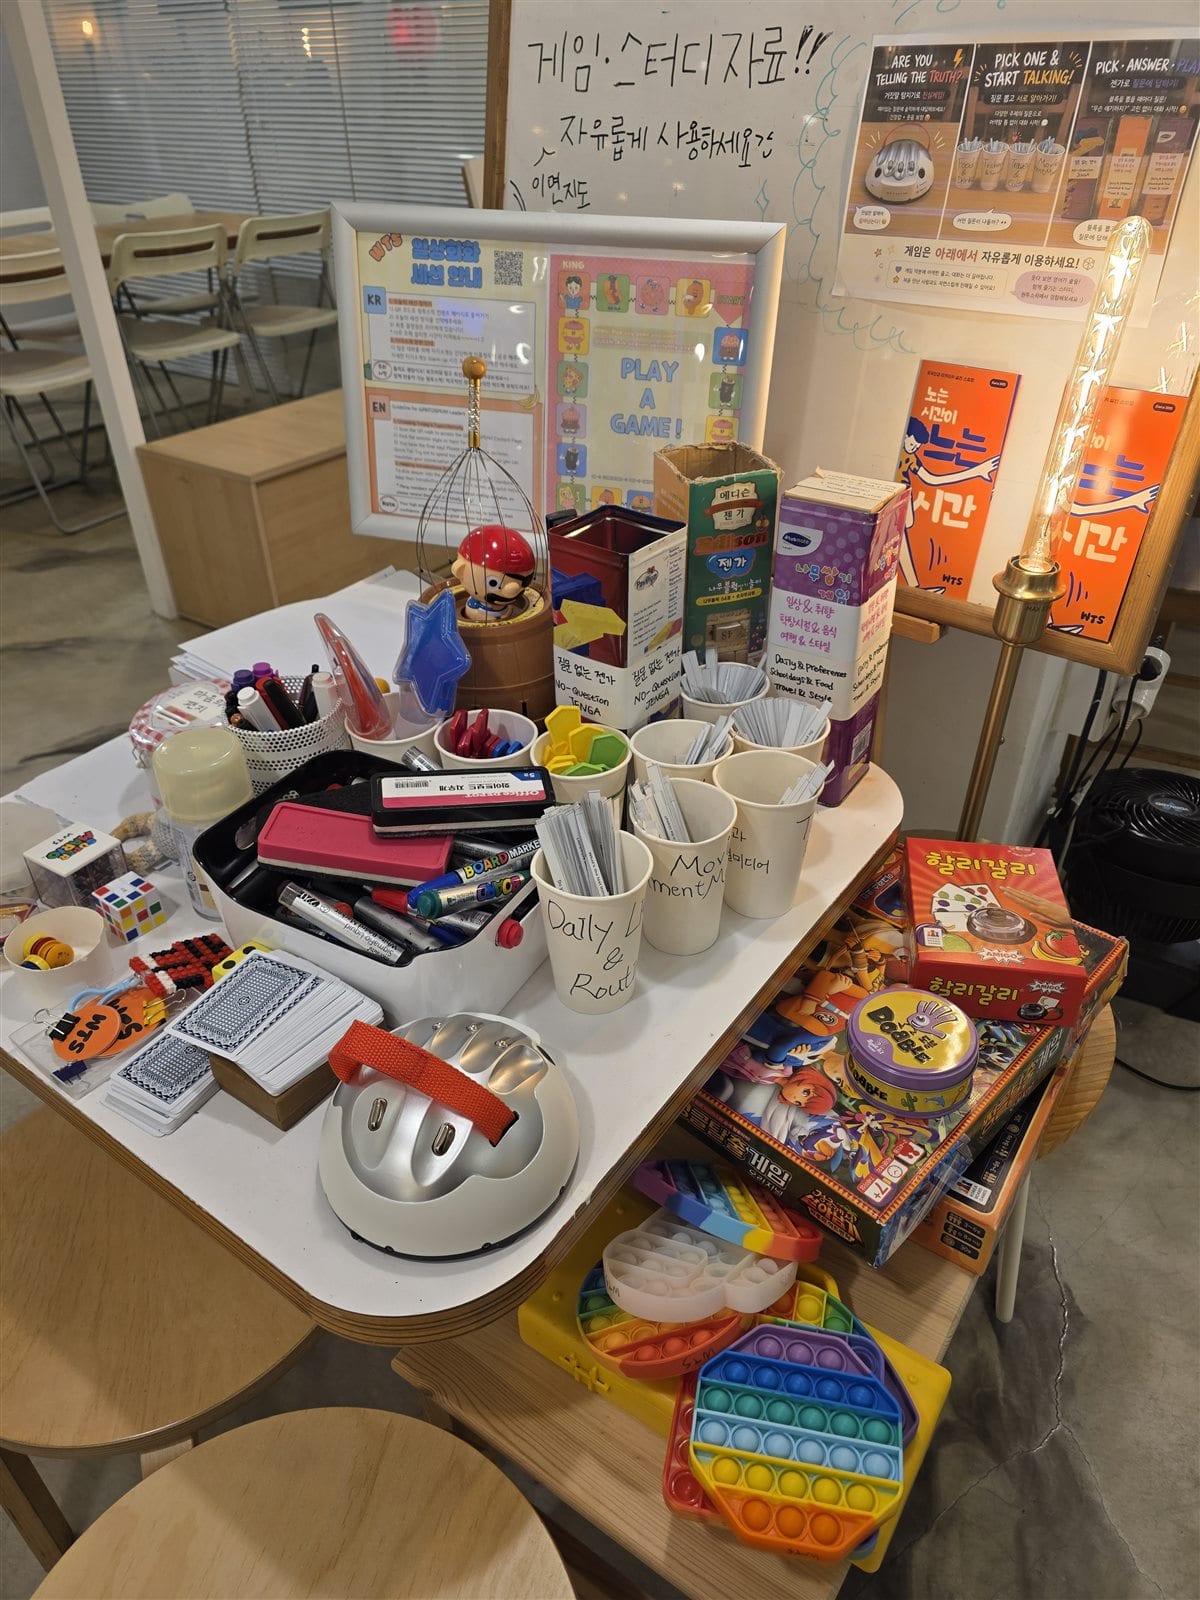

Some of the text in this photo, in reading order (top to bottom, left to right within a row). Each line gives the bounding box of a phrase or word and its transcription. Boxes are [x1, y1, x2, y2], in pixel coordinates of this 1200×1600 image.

[891, 54, 933, 69] ARE YOU
[994, 49, 1059, 68] PICK ONE &
[1095, 60, 1120, 76] PICK
[1126, 57, 1170, 73] ANSWER
[876, 69, 963, 87] TELLING THE TRUTH?
[984, 69, 1075, 88] START TALKING!
[560, 115, 753, 168] 자유롭게 사용하세요
[532, 173, 591, 209] 이면지도
[369, 232, 403, 262] WTS
[562, 260, 585, 270] KING
[904, 245, 1081, 270] 게임은 아래에서 자유롭게 이용하세요!
[367, 294, 382, 306] KR
[620, 357, 680, 383] PLAY
[639, 387, 656, 410] A
[924, 386, 949, 404] 노는
[372, 401, 386, 412] EN
[921, 405, 958, 425] 시간이
[610, 413, 671, 439] GAME
[719, 488, 751, 500] 에디슨
[913, 489, 977, 529] 시간
[1049, 518, 1128, 564] 시간
[717, 557, 748, 569] 젠가
[941, 573, 963, 586] WTS
[1080, 610, 1106, 625] WTS
[822, 625, 838, 639] 음식
[809, 640, 831, 653] 스타일
[815, 679, 834, 690] Food
[808, 690, 833, 703] Style
[464, 838, 542, 879] BOARD MARKE
[925, 851, 1039, 880] 할리갈리
[602, 946, 624, 971] &
[985, 951, 1018, 960] AMIGO
[570, 965, 635, 999] Rout
[928, 977, 1019, 1006] 할리갈리
[1035, 983, 1061, 991] AMIGO
[68, 1013, 107, 1054] WTS
[867, 1005, 933, 1064] DOBBLE
[746, 1144, 792, 1190] 게임
